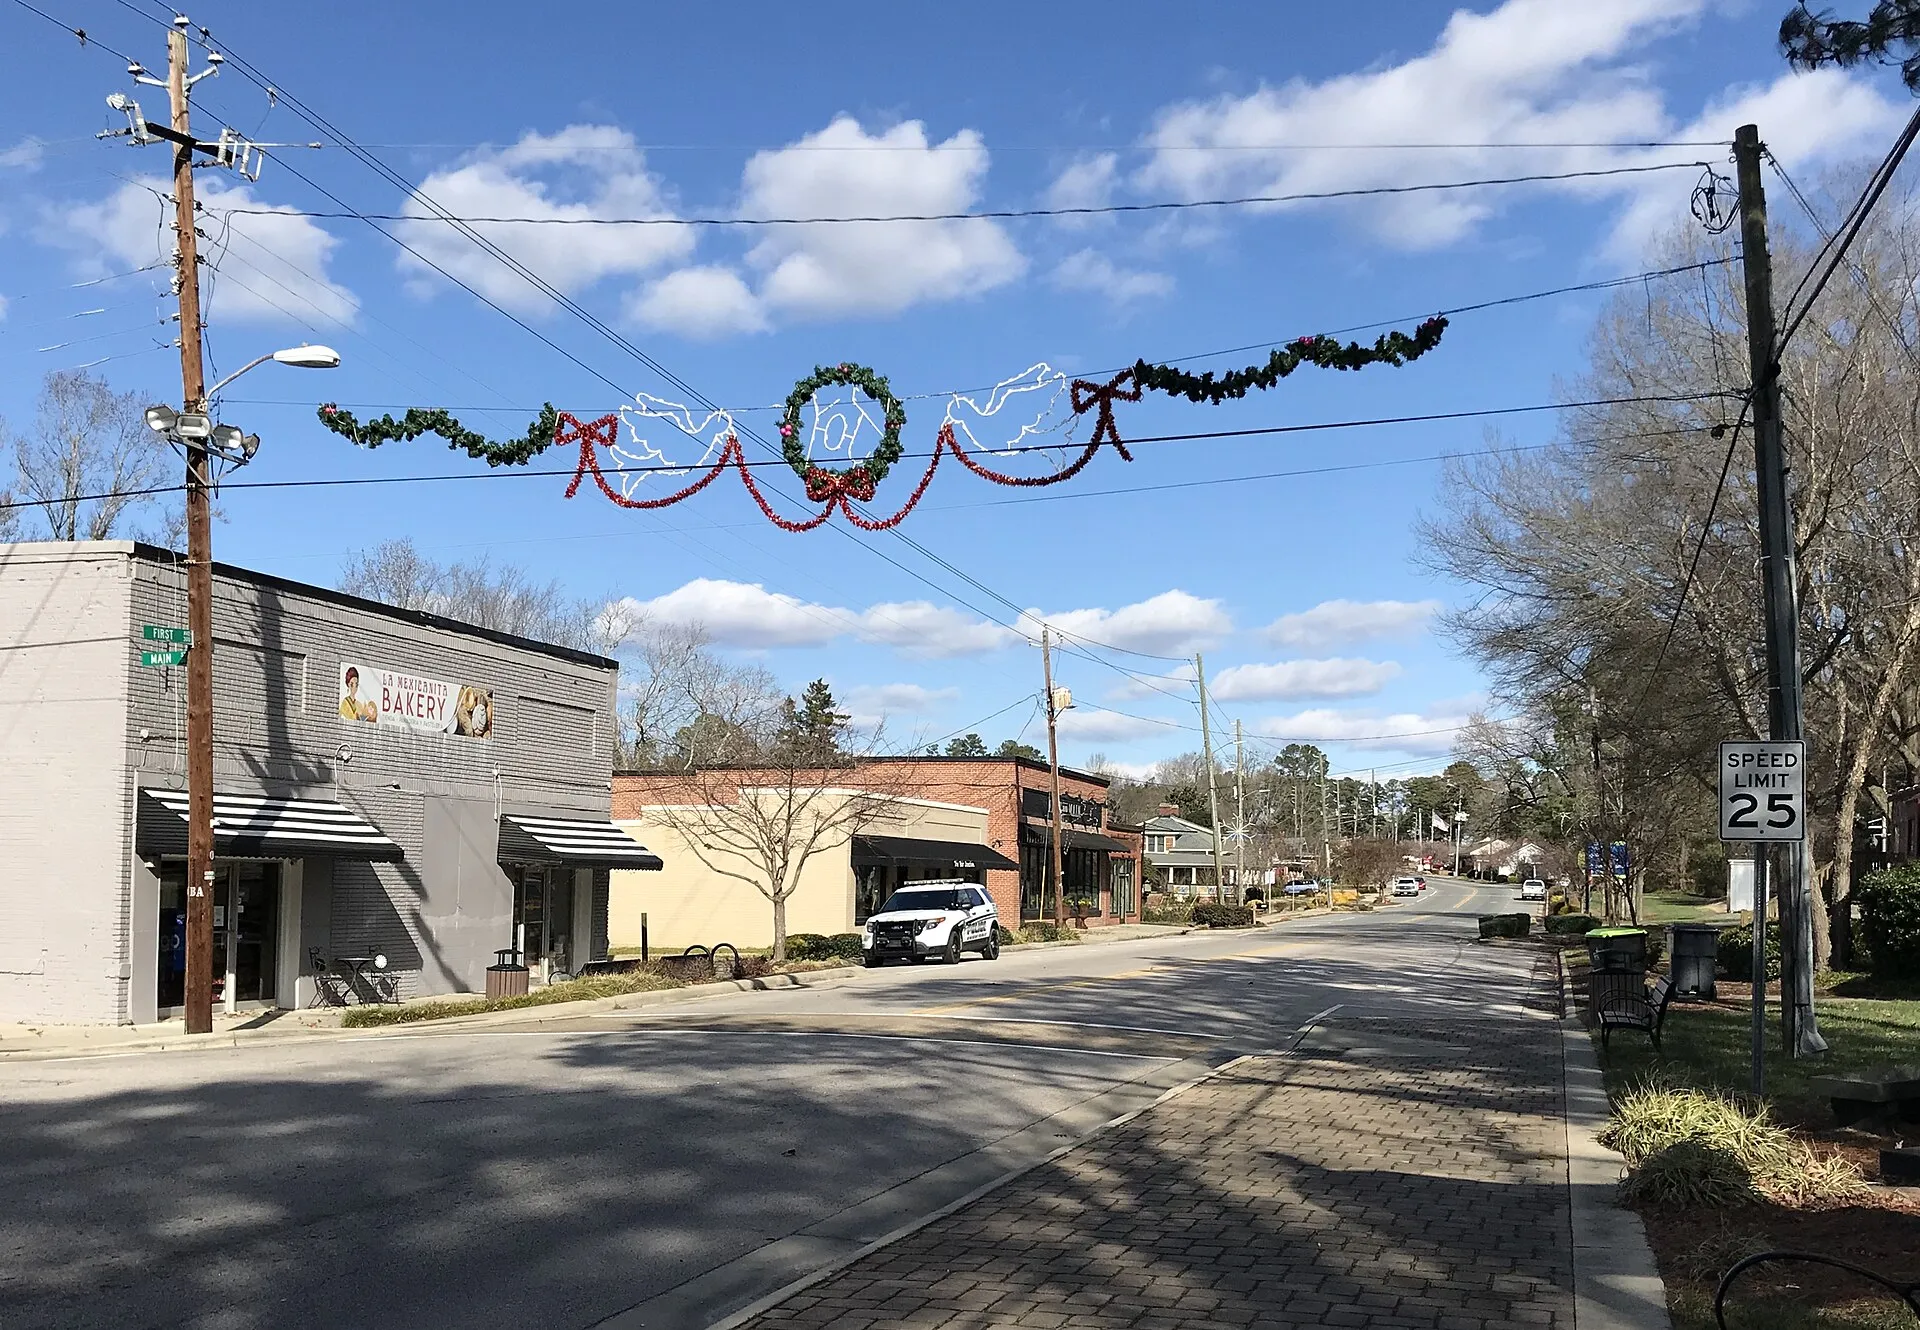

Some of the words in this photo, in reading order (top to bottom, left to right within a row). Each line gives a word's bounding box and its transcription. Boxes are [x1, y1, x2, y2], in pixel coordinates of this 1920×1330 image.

[153, 627, 174, 640] FIRST
[150, 653, 172, 665] MAIN
[382, 673, 394, 687] LA
[397, 676, 448, 697] MEXICANITA
[382, 687, 447, 721] BAKERY
[1727, 753, 1798, 768] SPEED
[1734, 773, 1790, 788] LIMIT
[1728, 793, 1797, 829] 25
